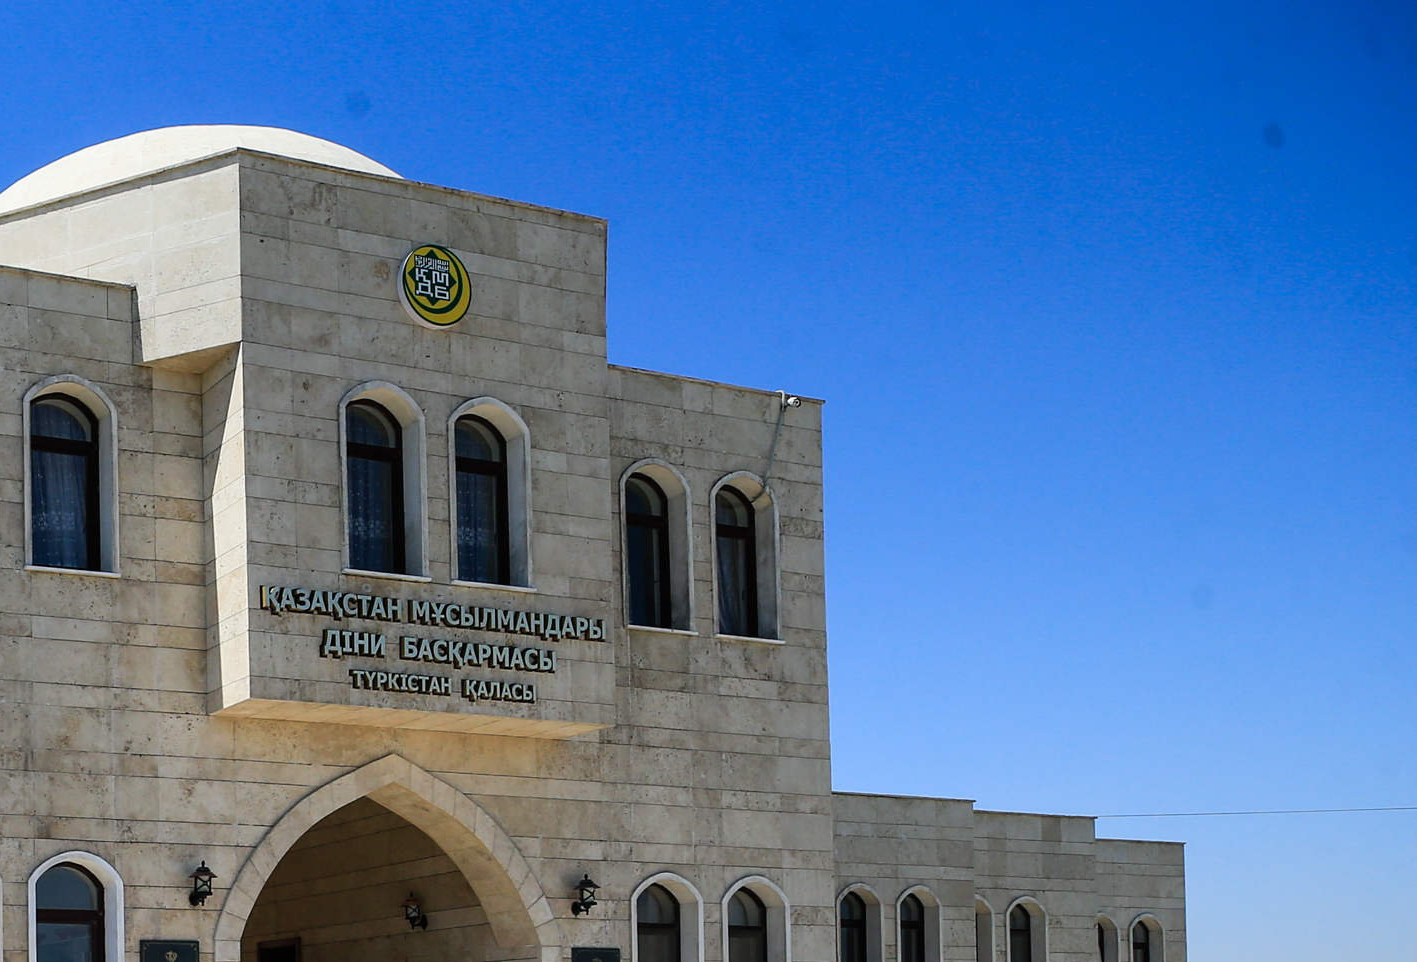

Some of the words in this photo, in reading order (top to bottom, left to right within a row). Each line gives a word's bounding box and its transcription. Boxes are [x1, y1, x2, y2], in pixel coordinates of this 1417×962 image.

[262, 585, 402, 622] ҚАЗАҚСТАН
[412, 600, 607, 640] МҰСЫЛМАНДАРЫ
[324, 629, 386, 656] ДІНИ
[404, 636, 558, 671] БАСҚАРМАСЫ
[353, 669, 452, 694] ТҮРКІСТАН
[466, 679, 537, 701] ҚАЛАСЫ
